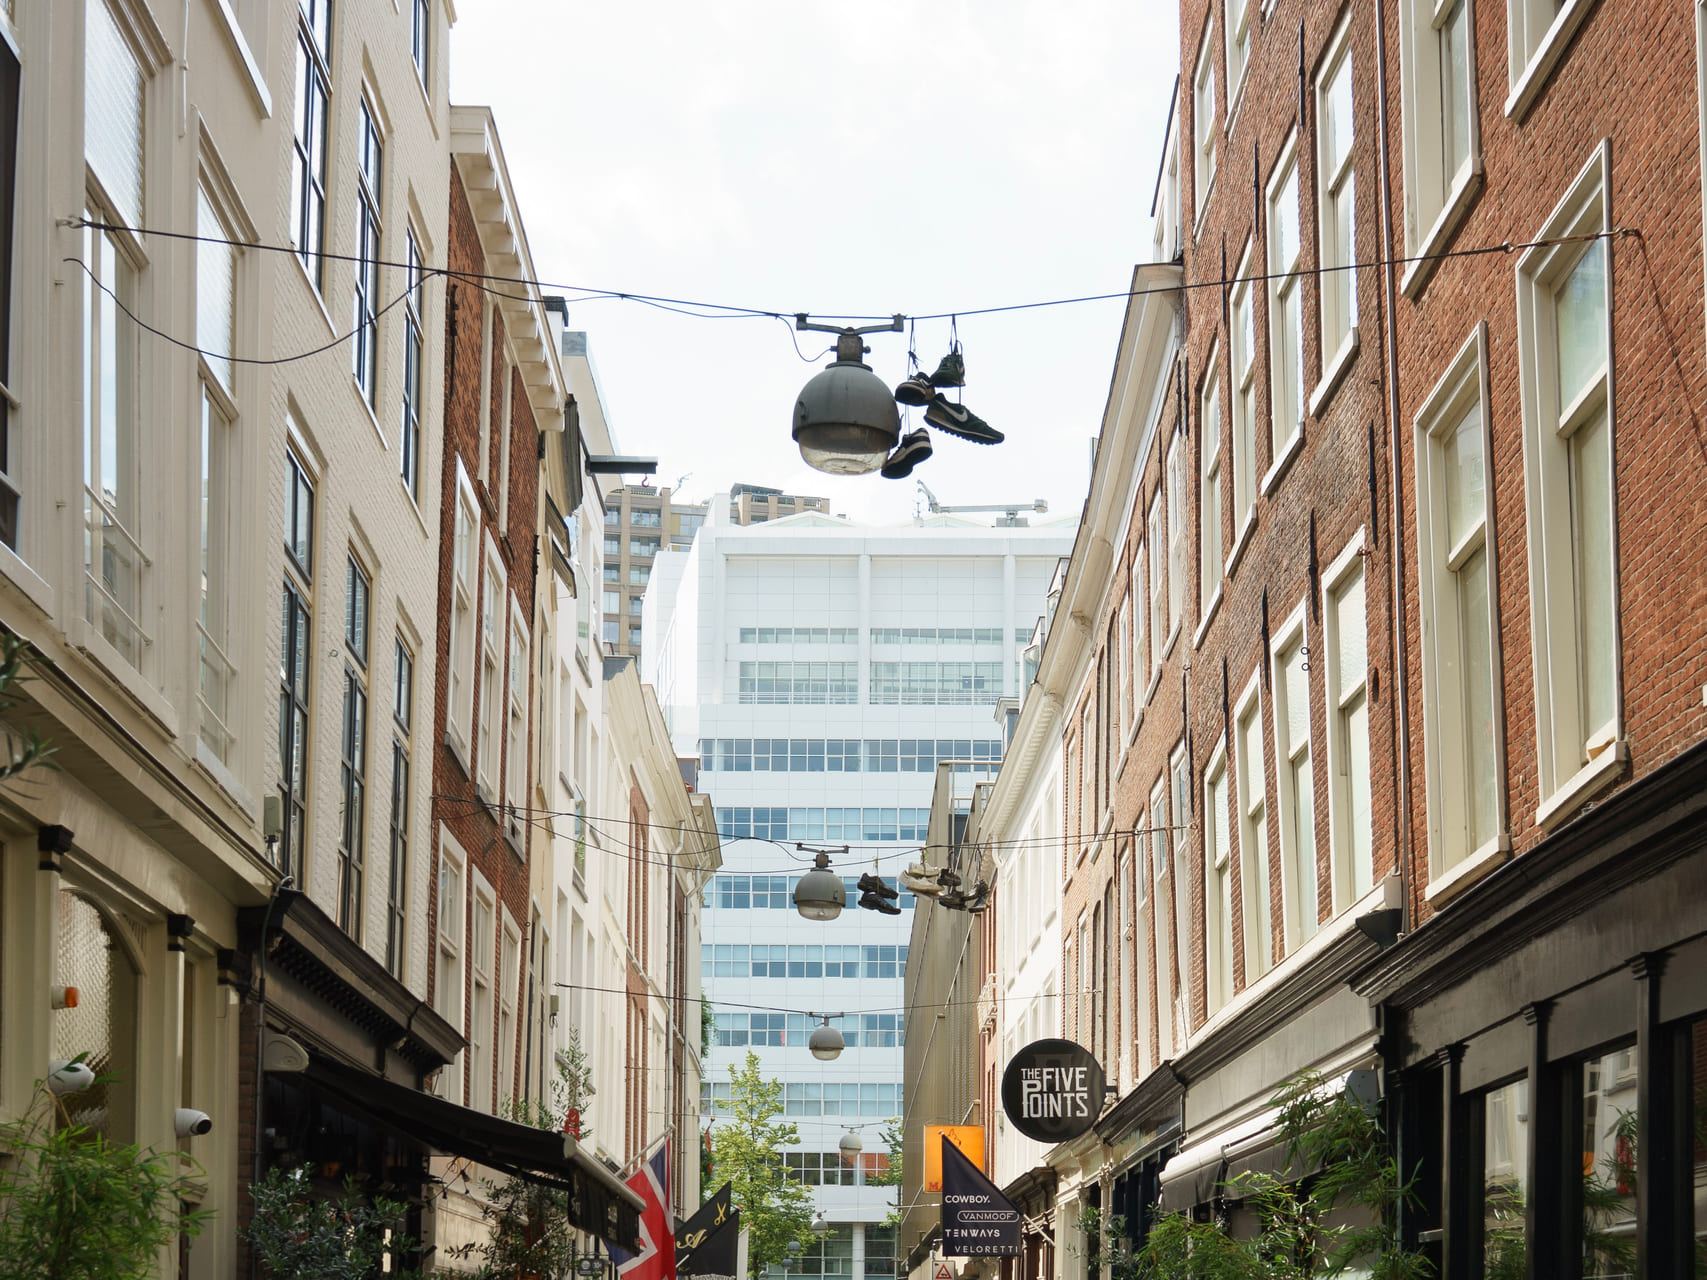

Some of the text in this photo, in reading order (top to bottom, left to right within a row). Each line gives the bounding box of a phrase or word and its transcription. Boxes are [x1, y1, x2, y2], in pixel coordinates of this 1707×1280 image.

[1021, 1067, 1088, 1092] THE FIVE
[1021, 1080, 1089, 1118] POINTS
[962, 1212, 1014, 1220] VANMOOF
[945, 1229, 1001, 1238] TENWAYS
[954, 1245, 1018, 1253] VELORETTI
